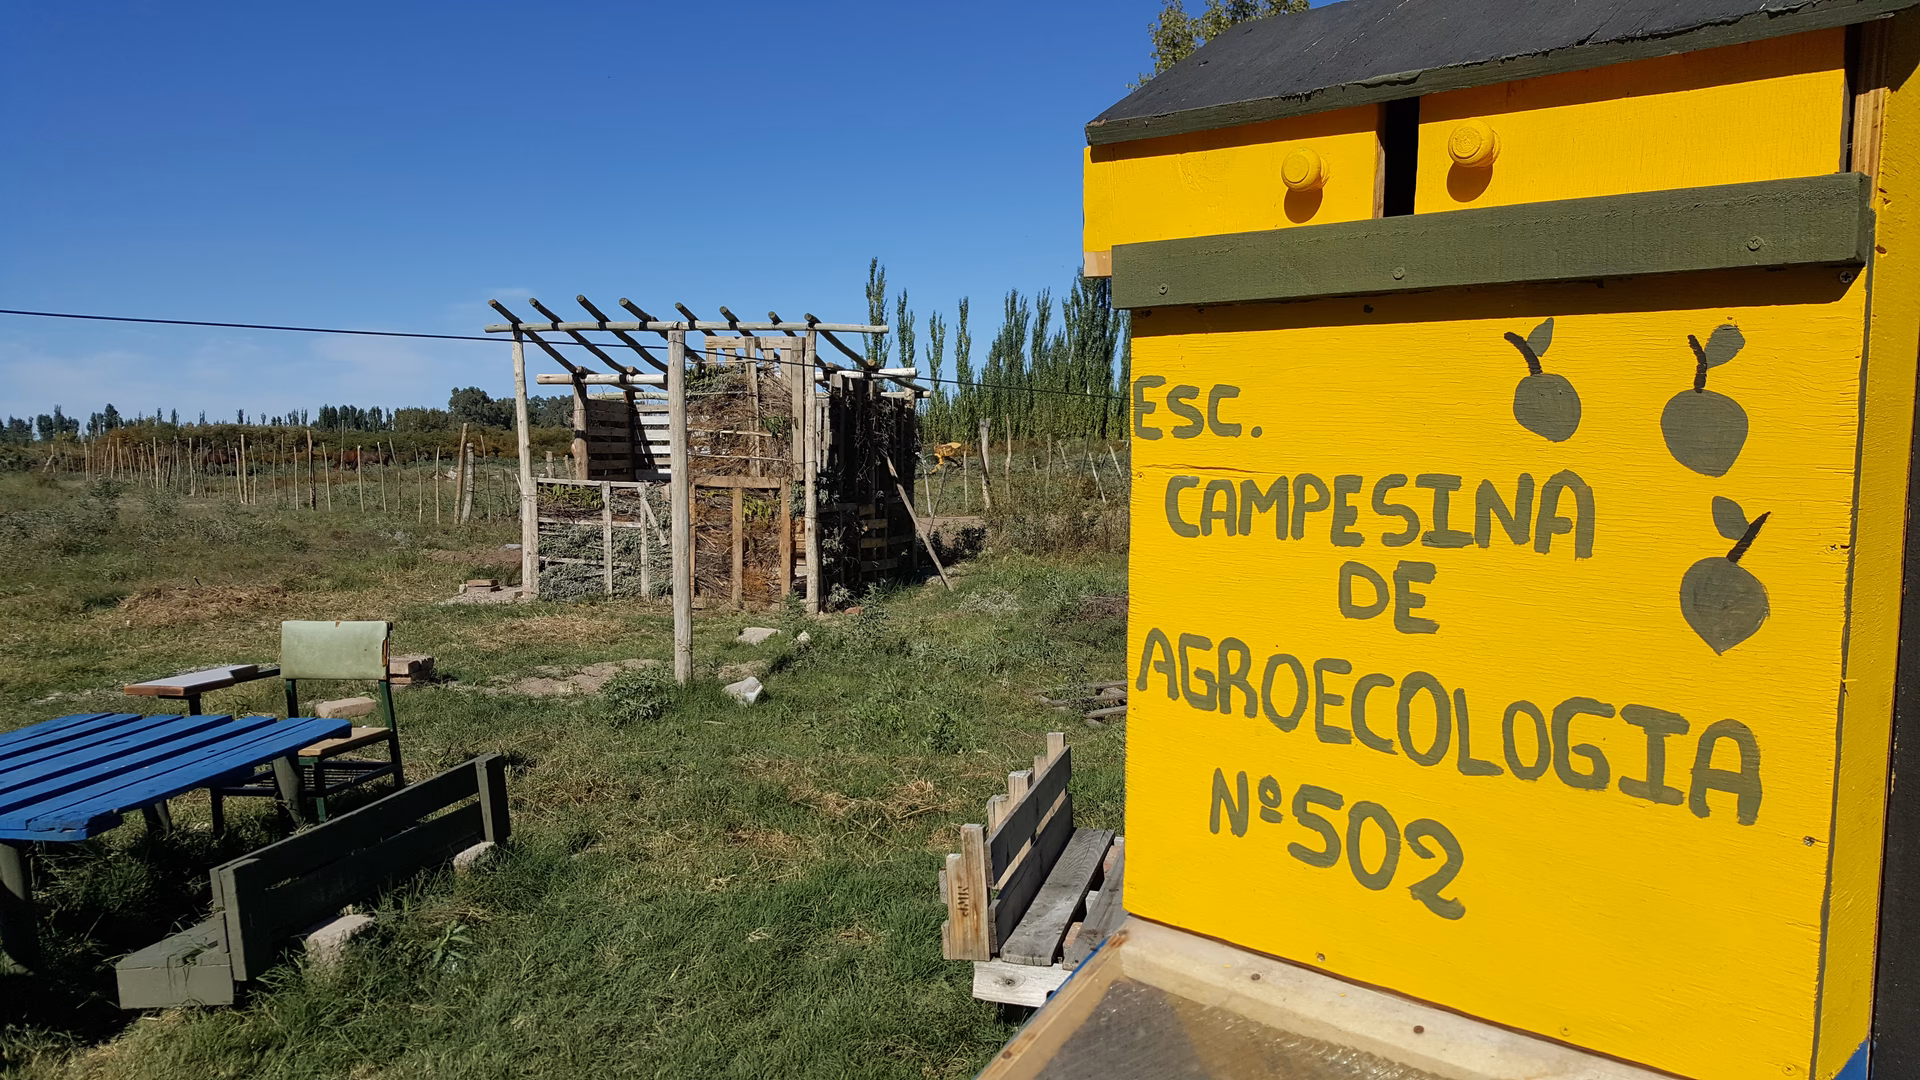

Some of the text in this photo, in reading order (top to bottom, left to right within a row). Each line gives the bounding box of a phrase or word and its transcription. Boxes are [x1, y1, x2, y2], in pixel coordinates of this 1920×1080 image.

[1133, 375, 1263, 441] ESC.
[1164, 469, 1595, 561] CAMPESINA
[1338, 561, 1439, 635] DE
[1135, 627, 1762, 827] AGROECOLOGIA
